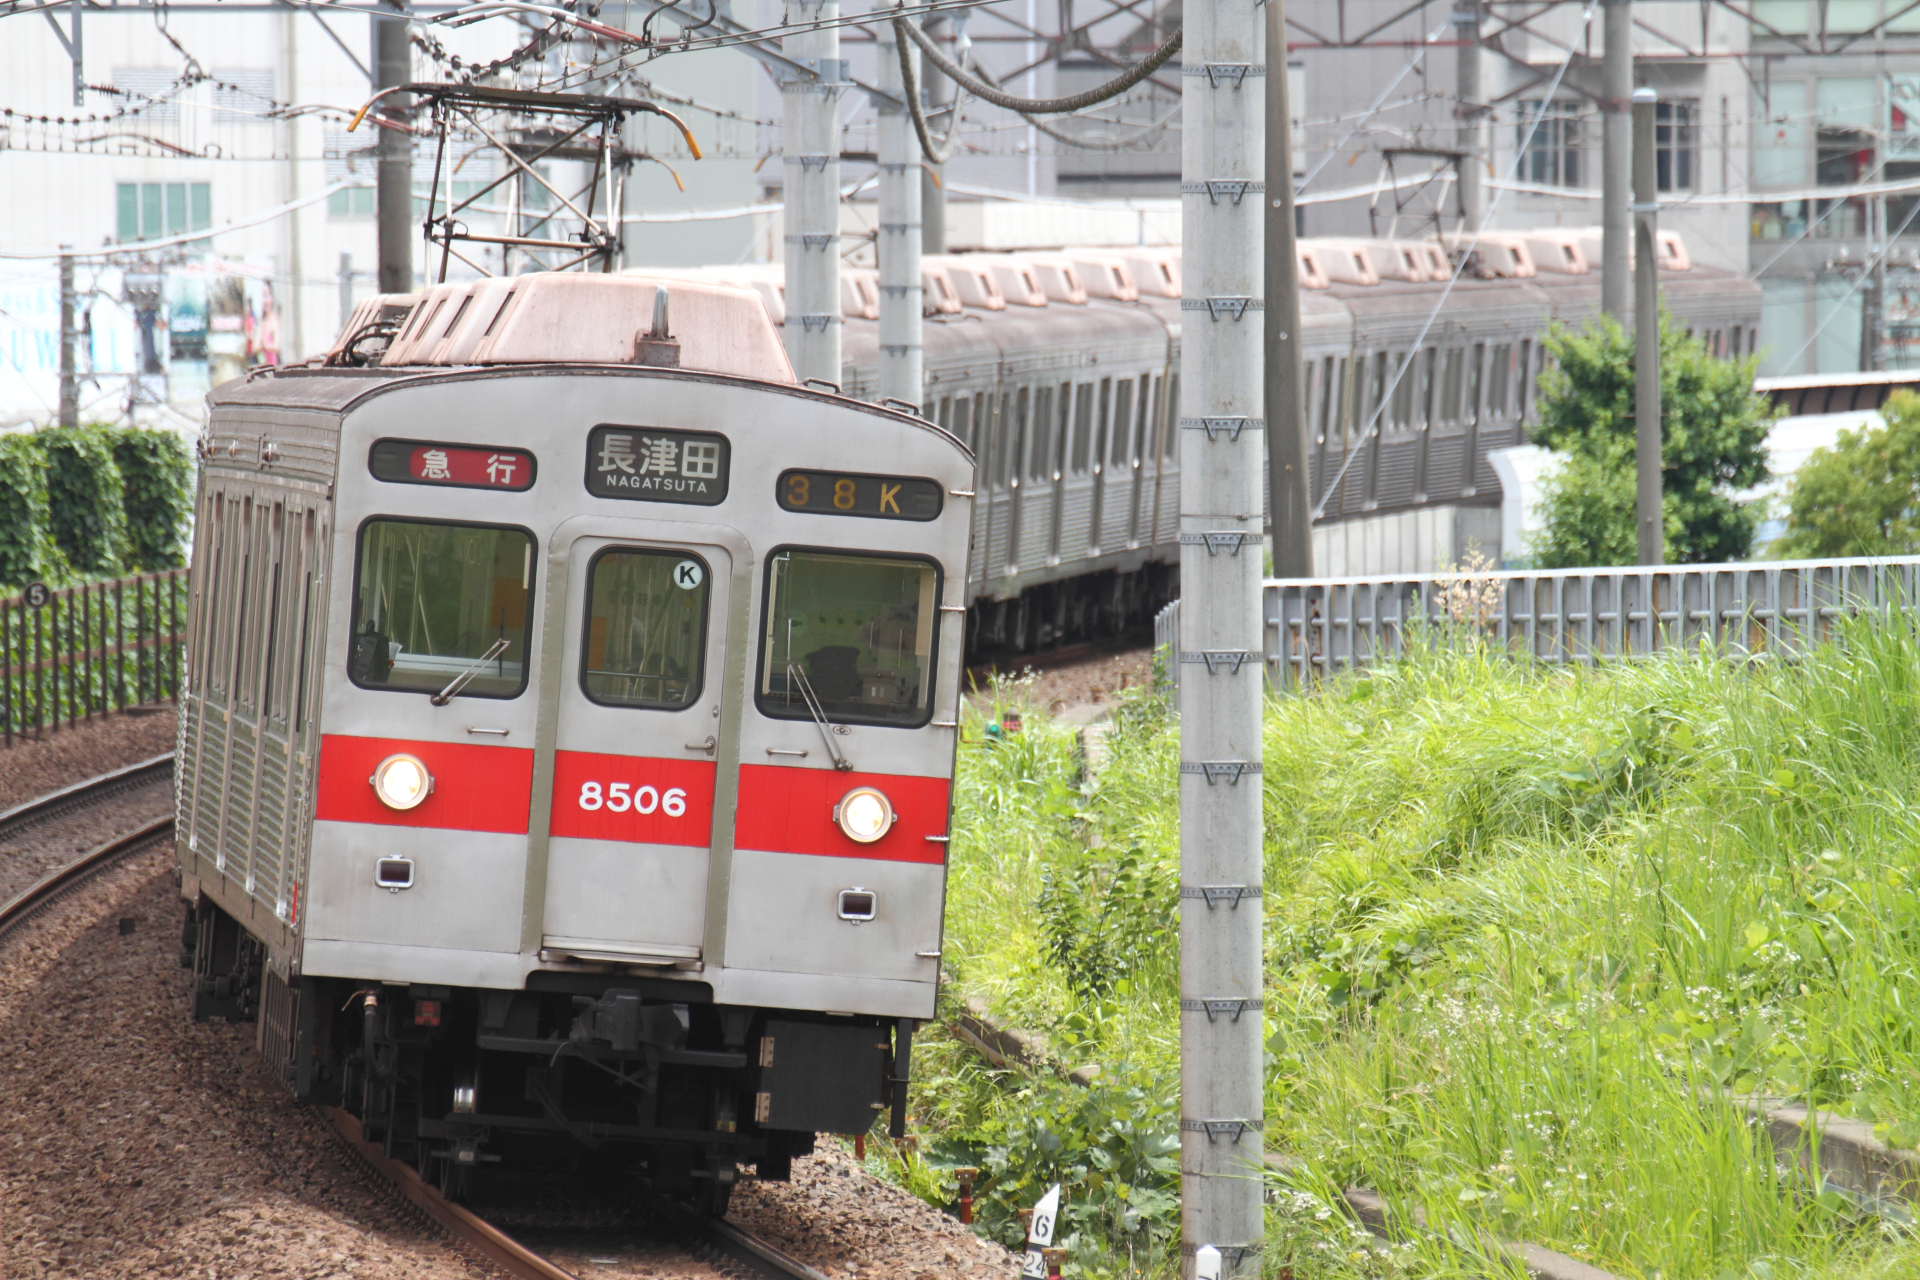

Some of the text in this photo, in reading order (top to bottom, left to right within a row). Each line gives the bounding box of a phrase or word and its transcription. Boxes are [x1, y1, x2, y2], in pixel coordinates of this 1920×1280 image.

[421, 449, 517, 485] 急行
[598, 433, 719, 479] 長津田
[606, 475, 708, 494] NAGATSUTA
[679, 565, 696, 585] K
[30, 584, 45, 606] 5
[579, 781, 687, 818] 8506
[1035, 1214, 1051, 1239] 6
[1023, 1253, 1047, 1277] 24
